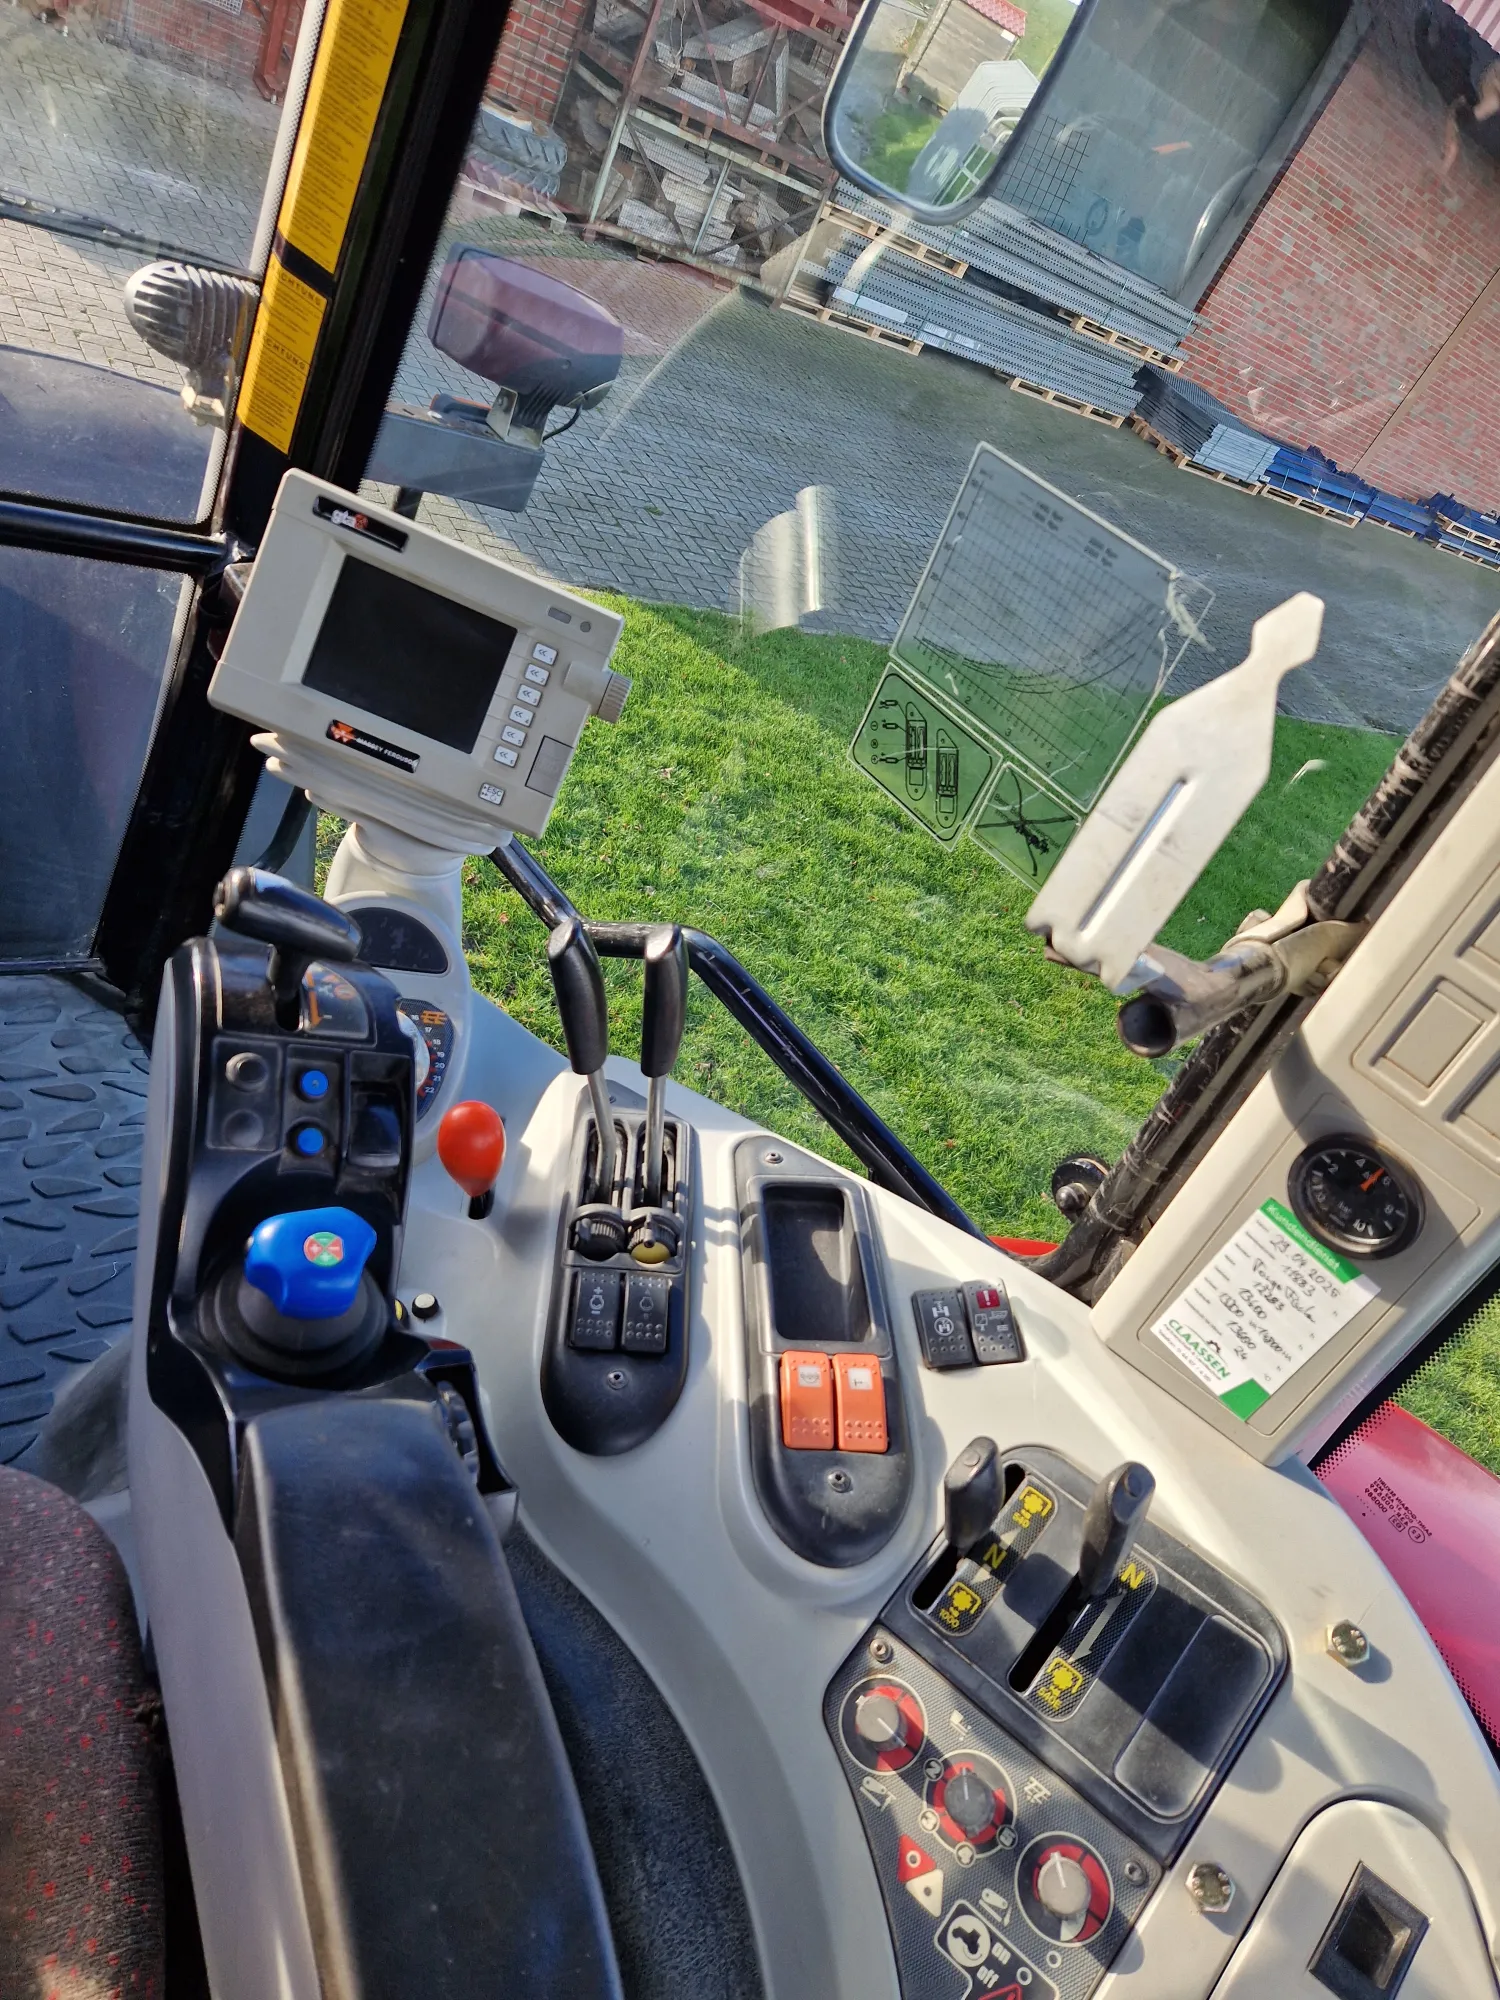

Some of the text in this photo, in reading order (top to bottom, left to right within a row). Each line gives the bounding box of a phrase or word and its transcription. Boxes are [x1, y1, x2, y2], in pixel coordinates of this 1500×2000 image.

[383, 749, 416, 766] FERGUSO
[424, 1086, 436, 1094] 22
[1327, 1163, 1339, 1175] 2
[1168, 1319, 1231, 1378] CLAASSEN
[983, 1543, 1007, 1569] N
[1120, 1562, 1145, 1591] N
[926, 1760, 941, 1778] 2
[921, 1813, 937, 1831] 3
[1000, 1826, 1016, 1846] 5
[991, 1941, 1012, 1965] on
[976, 1965, 999, 1989] off
